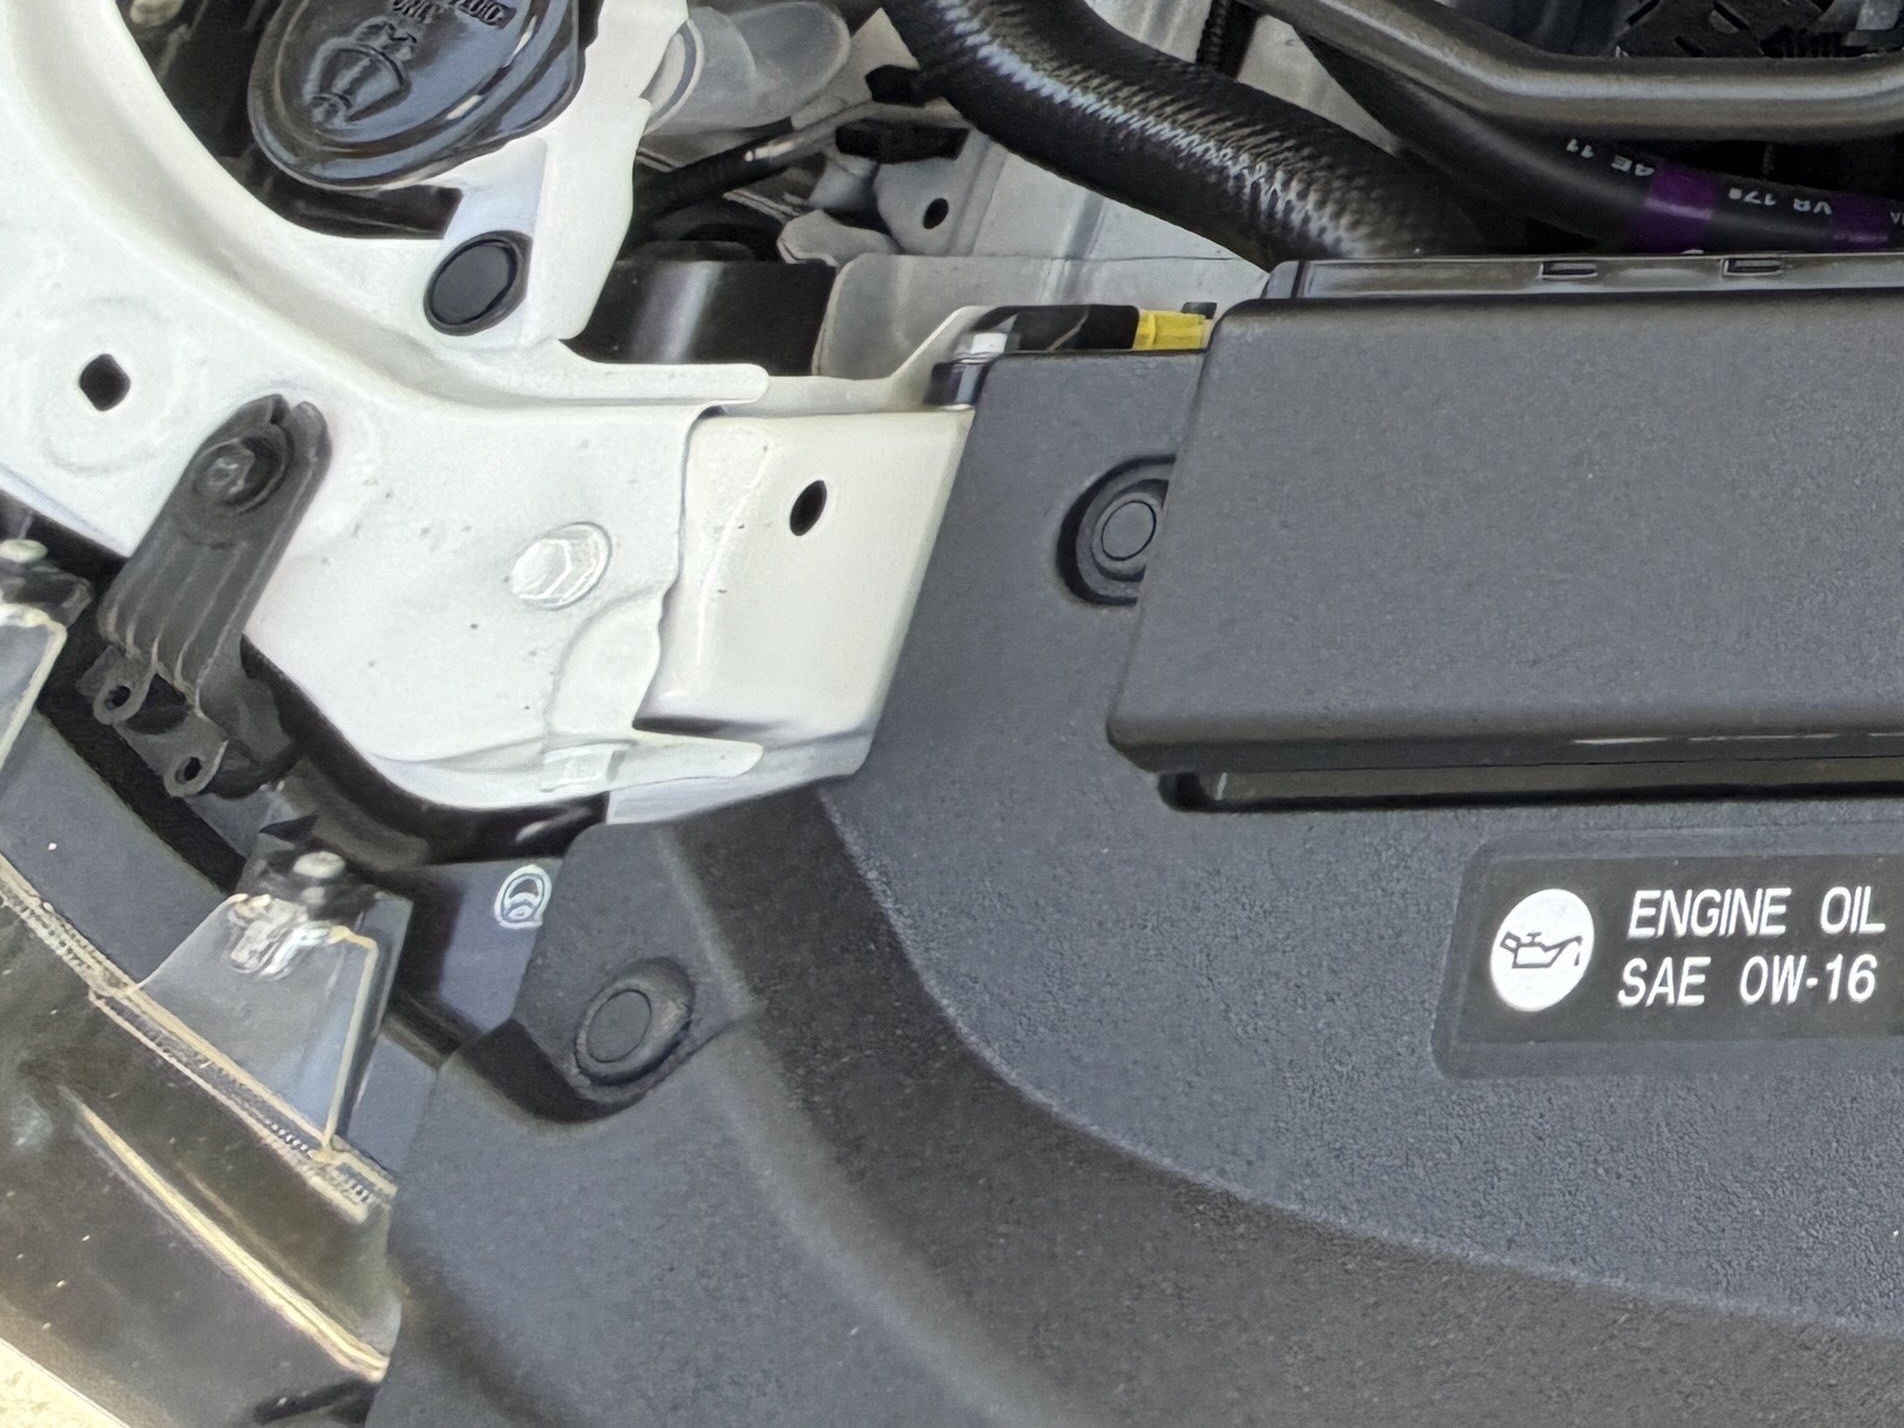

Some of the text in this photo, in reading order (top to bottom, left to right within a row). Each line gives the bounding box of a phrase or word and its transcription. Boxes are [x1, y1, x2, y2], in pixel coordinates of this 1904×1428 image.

[1627, 887, 1886, 939] ENGINE OIL
[1616, 953, 1876, 1006] SAE 0W-16
